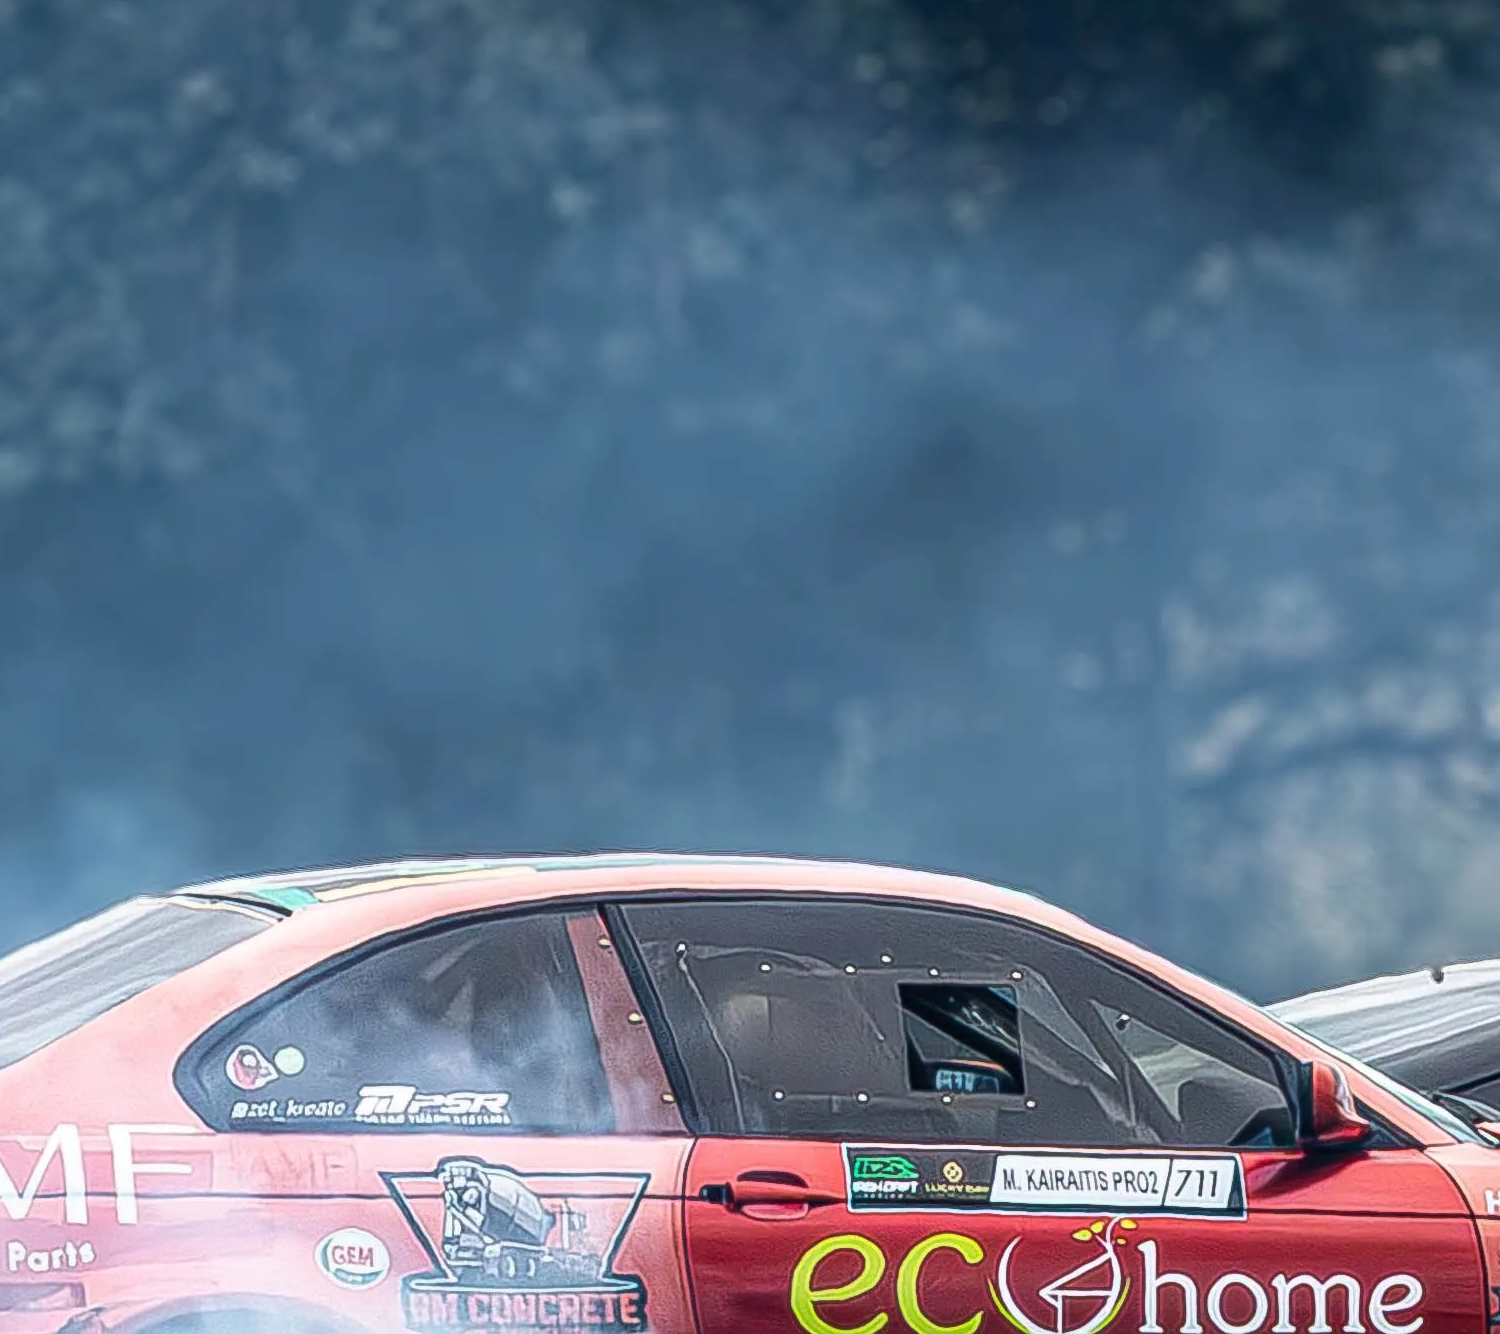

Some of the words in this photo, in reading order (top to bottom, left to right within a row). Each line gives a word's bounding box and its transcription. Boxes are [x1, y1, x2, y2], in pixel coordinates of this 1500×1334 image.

[1002, 1167, 1022, 1192] M.
[1027, 1168, 1109, 1193] KAIRAITIS
[1173, 1169, 1219, 1198] 711
[7, 1239, 97, 1273] Parts
[332, 1244, 375, 1267] GEM
[468, 1292, 642, 1326] CONCRETE
